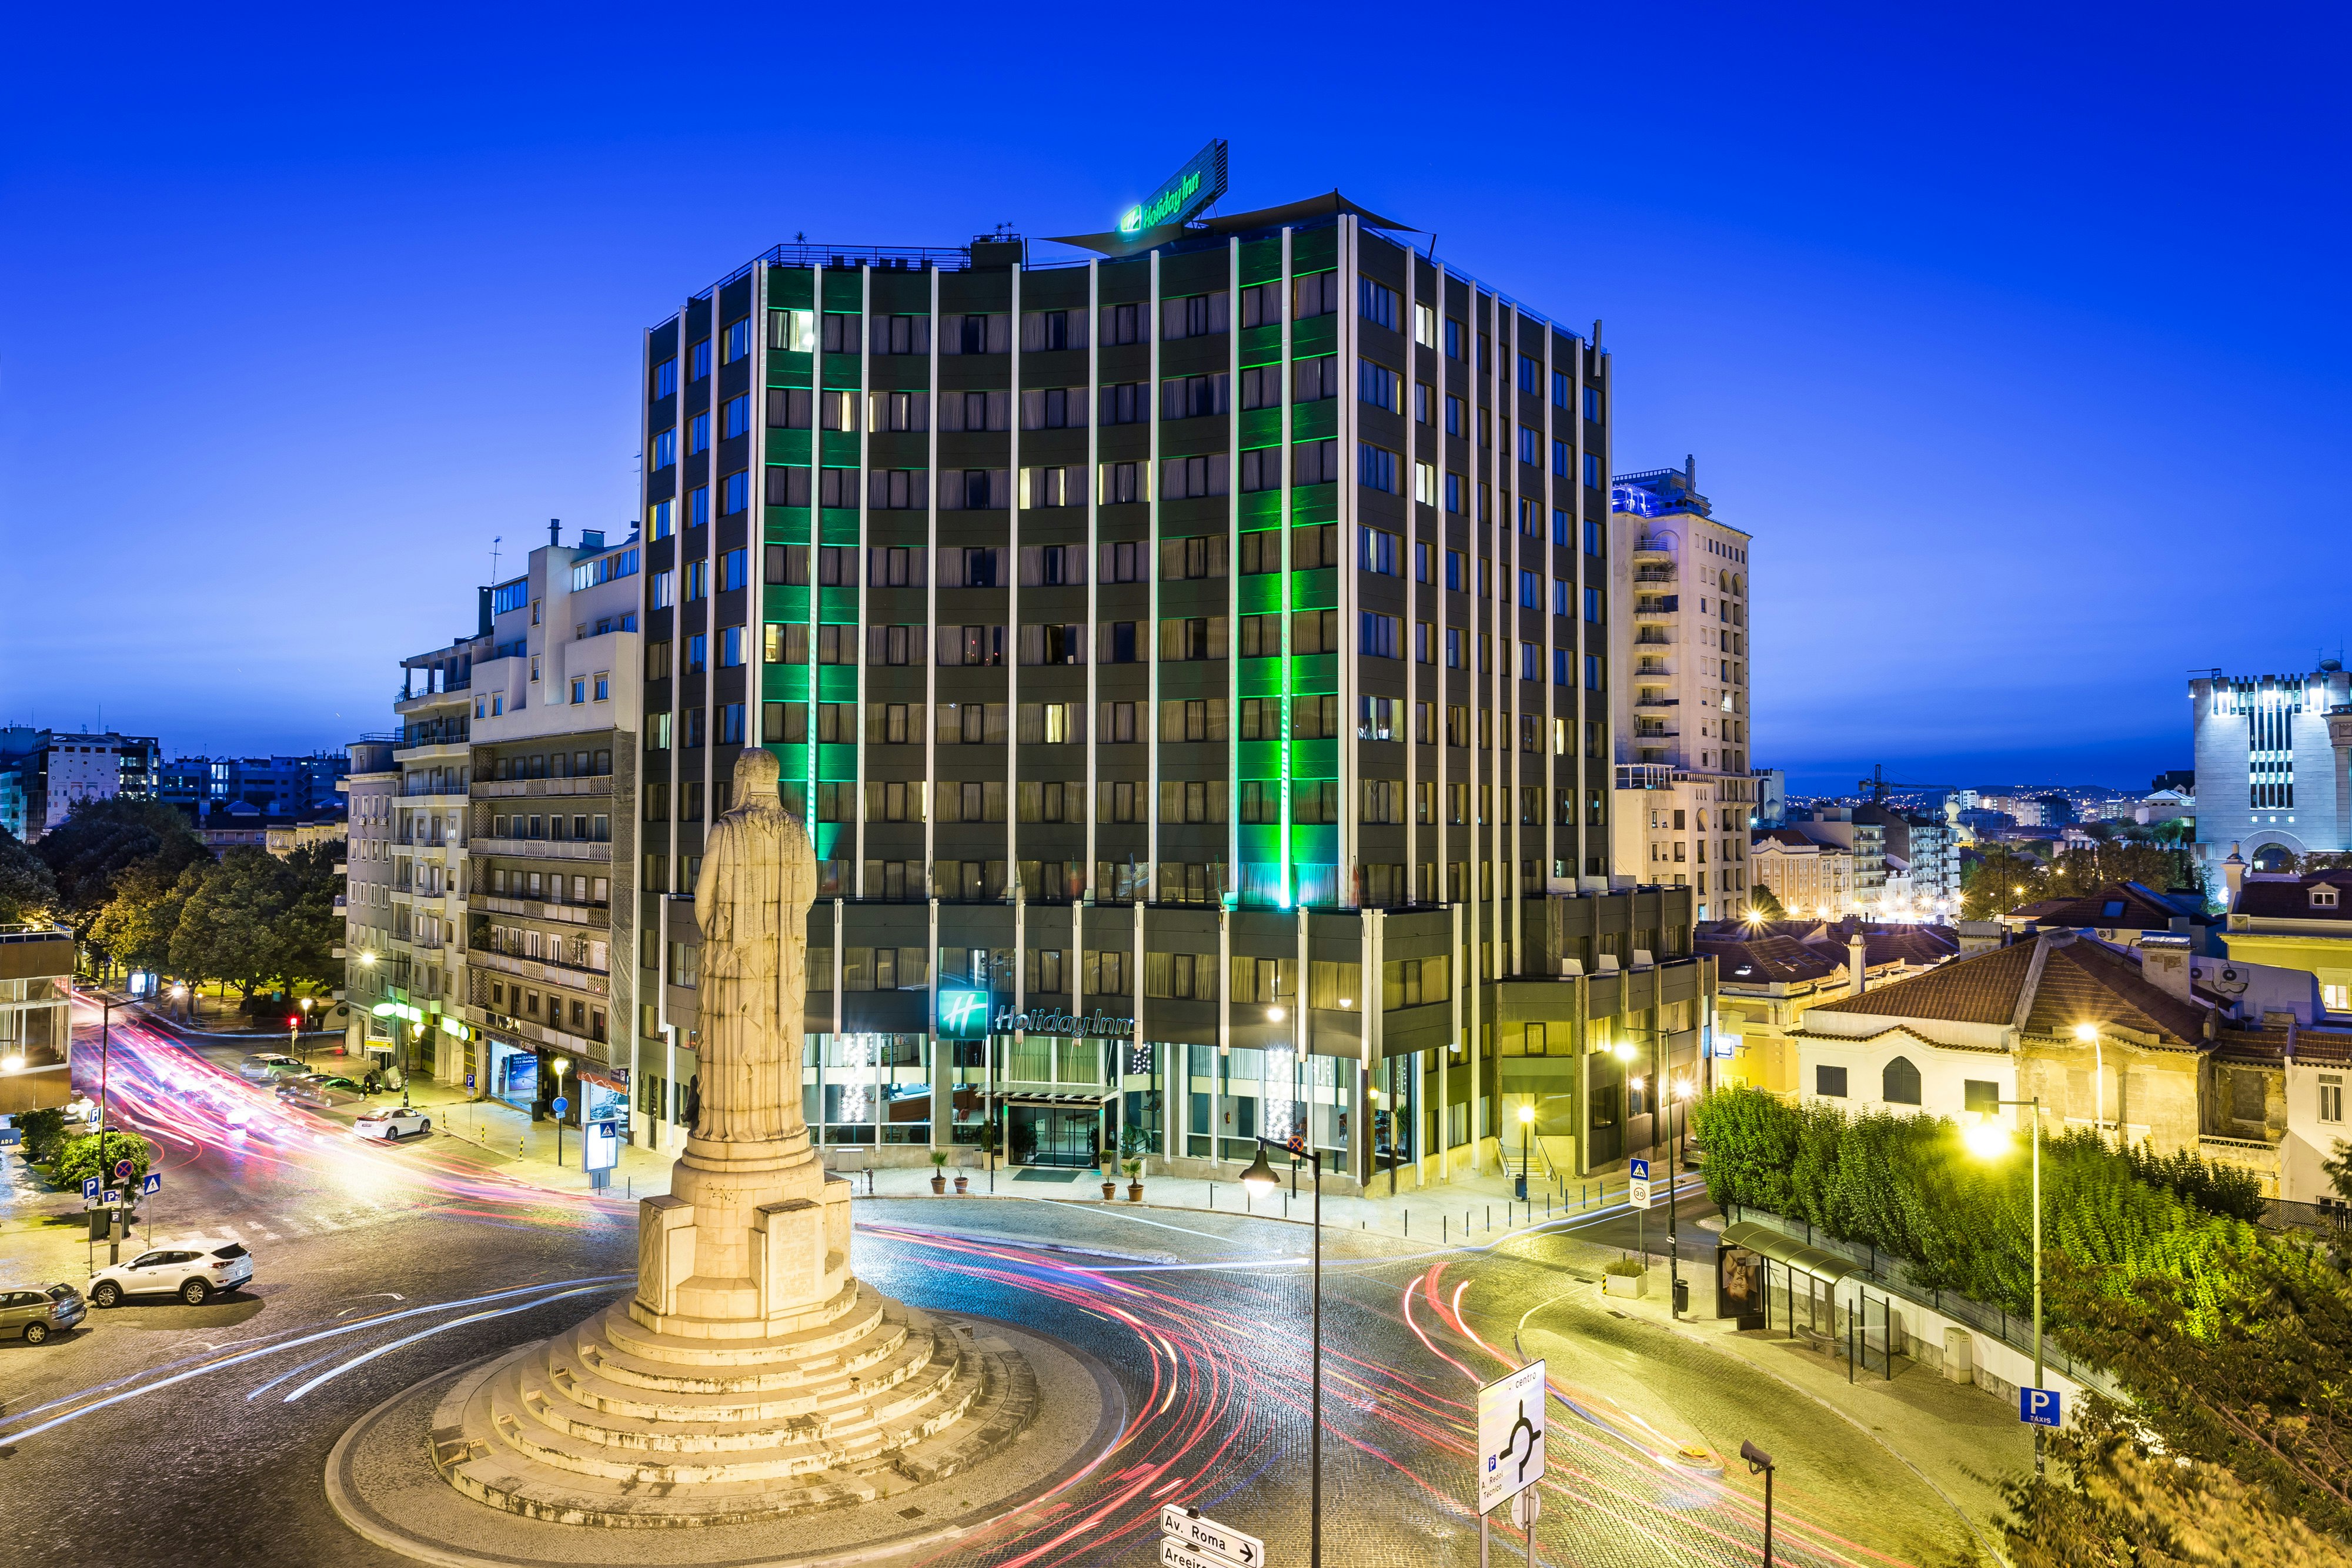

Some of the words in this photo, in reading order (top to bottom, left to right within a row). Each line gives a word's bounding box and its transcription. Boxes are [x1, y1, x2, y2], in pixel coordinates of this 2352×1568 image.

[1143, 188, 1182, 228] Holiday
[1182, 173, 1200, 200] Inn
[995, 1005, 1090, 1038] Holiday
[1093, 1008, 1131, 1035] Inn
[524, 1041, 536, 1052] smart
[467, 1075, 473, 1086] P
[86, 1181, 96, 1196] P
[108, 1192, 114, 1201] P
[1516, 1372, 1536, 1388] centro
[2031, 1390, 2049, 1415] P
[2030, 1415, 2051, 1423] TÁXIS
[1490, 1459, 1495, 1471] P
[1489, 1469, 1503, 1485] Redol
[1165, 1515, 1183, 1533] Av.
[1192, 1525, 1225, 1551] Roma
[1165, 1547, 1207, 1568] Areeir
